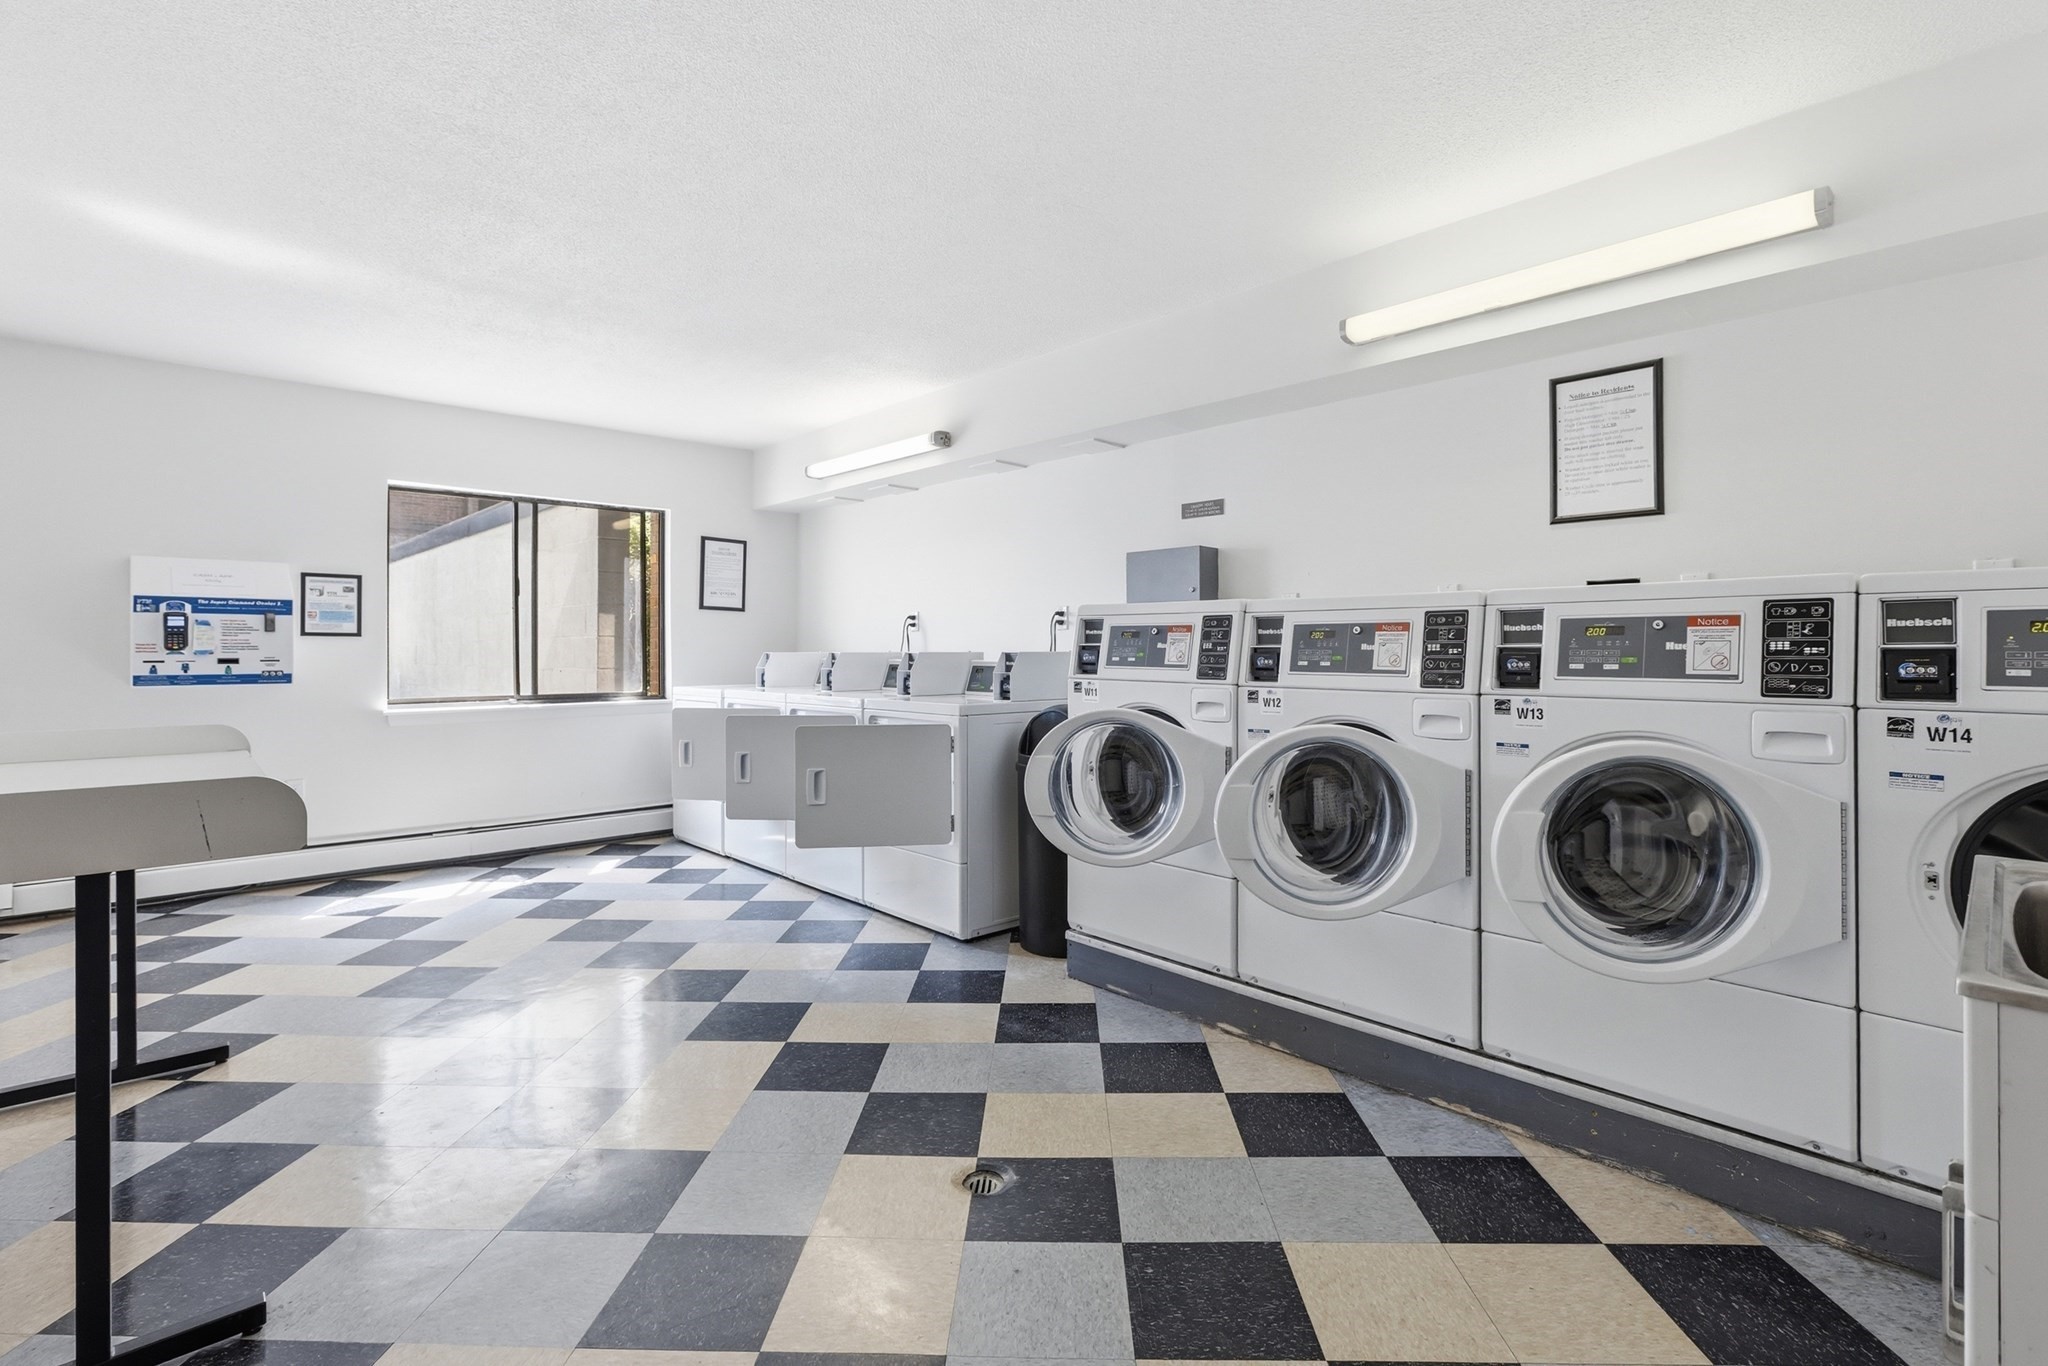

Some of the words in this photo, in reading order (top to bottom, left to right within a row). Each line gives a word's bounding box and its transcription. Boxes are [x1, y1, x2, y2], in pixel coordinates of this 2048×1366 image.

[1569, 391, 1590, 399] Notice
[1600, 384, 1635, 394] Residents
[1697, 618, 1729, 626] Notice
[1886, 617, 1953, 627] Huebsch
[1503, 624, 1543, 632] Huebsch
[1084, 687, 1098, 697] W11
[1262, 697, 1282, 708] W12
[1516, 707, 1544, 720] W13
[1926, 726, 1973, 744] W14
